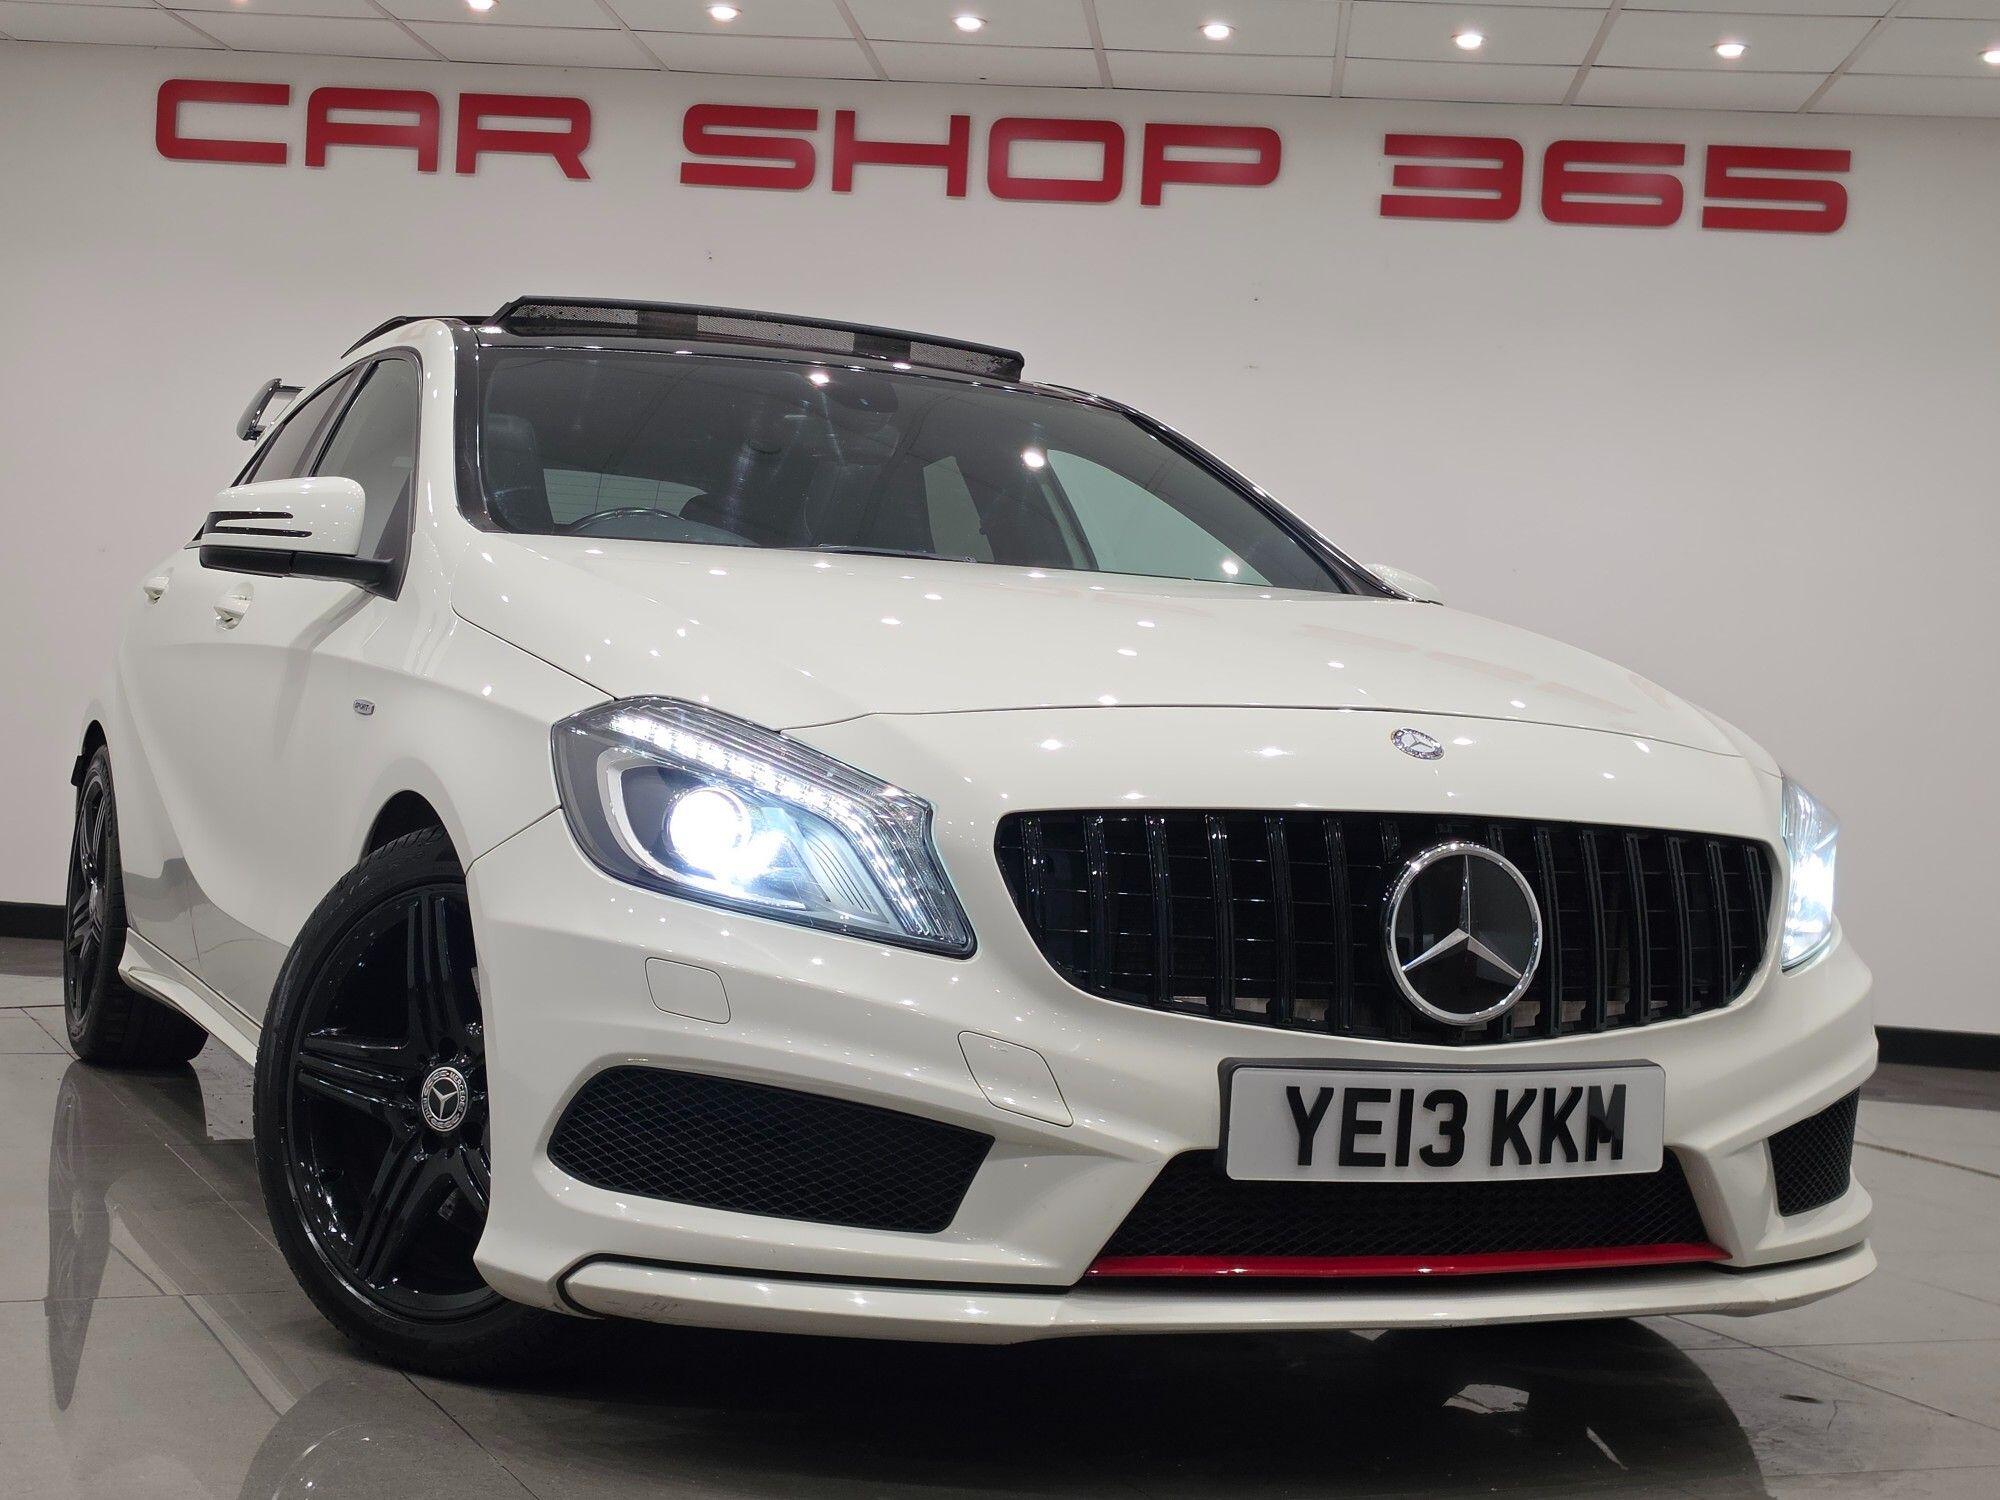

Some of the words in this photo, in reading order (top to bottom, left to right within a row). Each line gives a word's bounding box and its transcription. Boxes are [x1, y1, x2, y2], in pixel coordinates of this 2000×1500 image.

[156, 79, 591, 181] CAR
[680, 104, 1281, 206] SHOP
[1380, 133, 1851, 234] 365
[449, 1071, 467, 1113] MERCEDES
[1285, 1085, 1469, 1168] YE13
[1489, 1083, 1627, 1167] KKM
